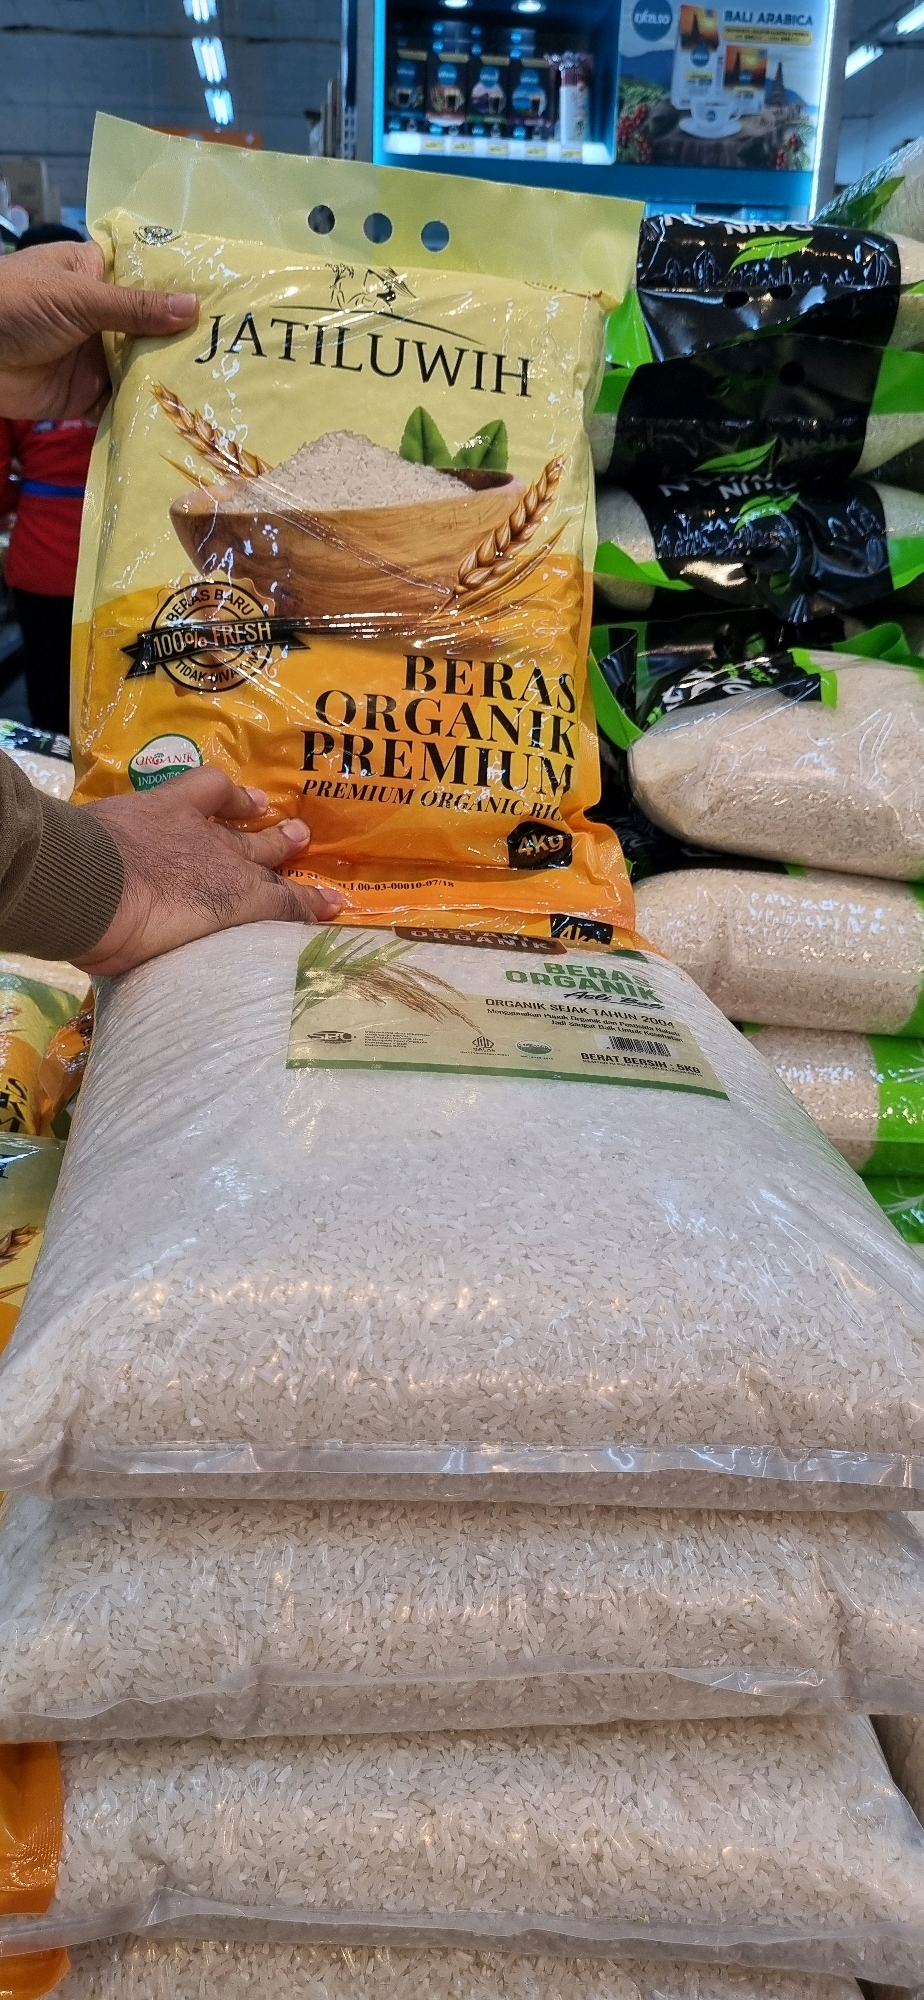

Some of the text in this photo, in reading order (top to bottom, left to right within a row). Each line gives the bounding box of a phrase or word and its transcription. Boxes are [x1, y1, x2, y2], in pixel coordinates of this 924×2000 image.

[724, 10, 813, 26] BALI ARABICA
[194, 312, 533, 398] JATILUWIH
[166, 589, 255, 622] BERAS BARU
[153, 621, 272, 658] 100% FRESH
[175, 659, 208, 684] TIDAK
[402, 653, 577, 715] BERAS
[314, 689, 577, 761] ORGANIK
[300, 730, 574, 796] PREMIUM
[302, 779, 564, 822] PREMIUM ORGANIC RIC
[410, 930, 551, 950] ORGANIK
[506, 969, 664, 1004] ORGANIK
[543, 961, 650, 987] BERAS
[485, 998, 676, 1029] ORGANIK SEJAK TAHUN 2004
[580, 1052, 620, 1063] BERAT
[623, 1056, 668, 1069] BERSIH
[676, 1063, 701, 1074] 5KG
